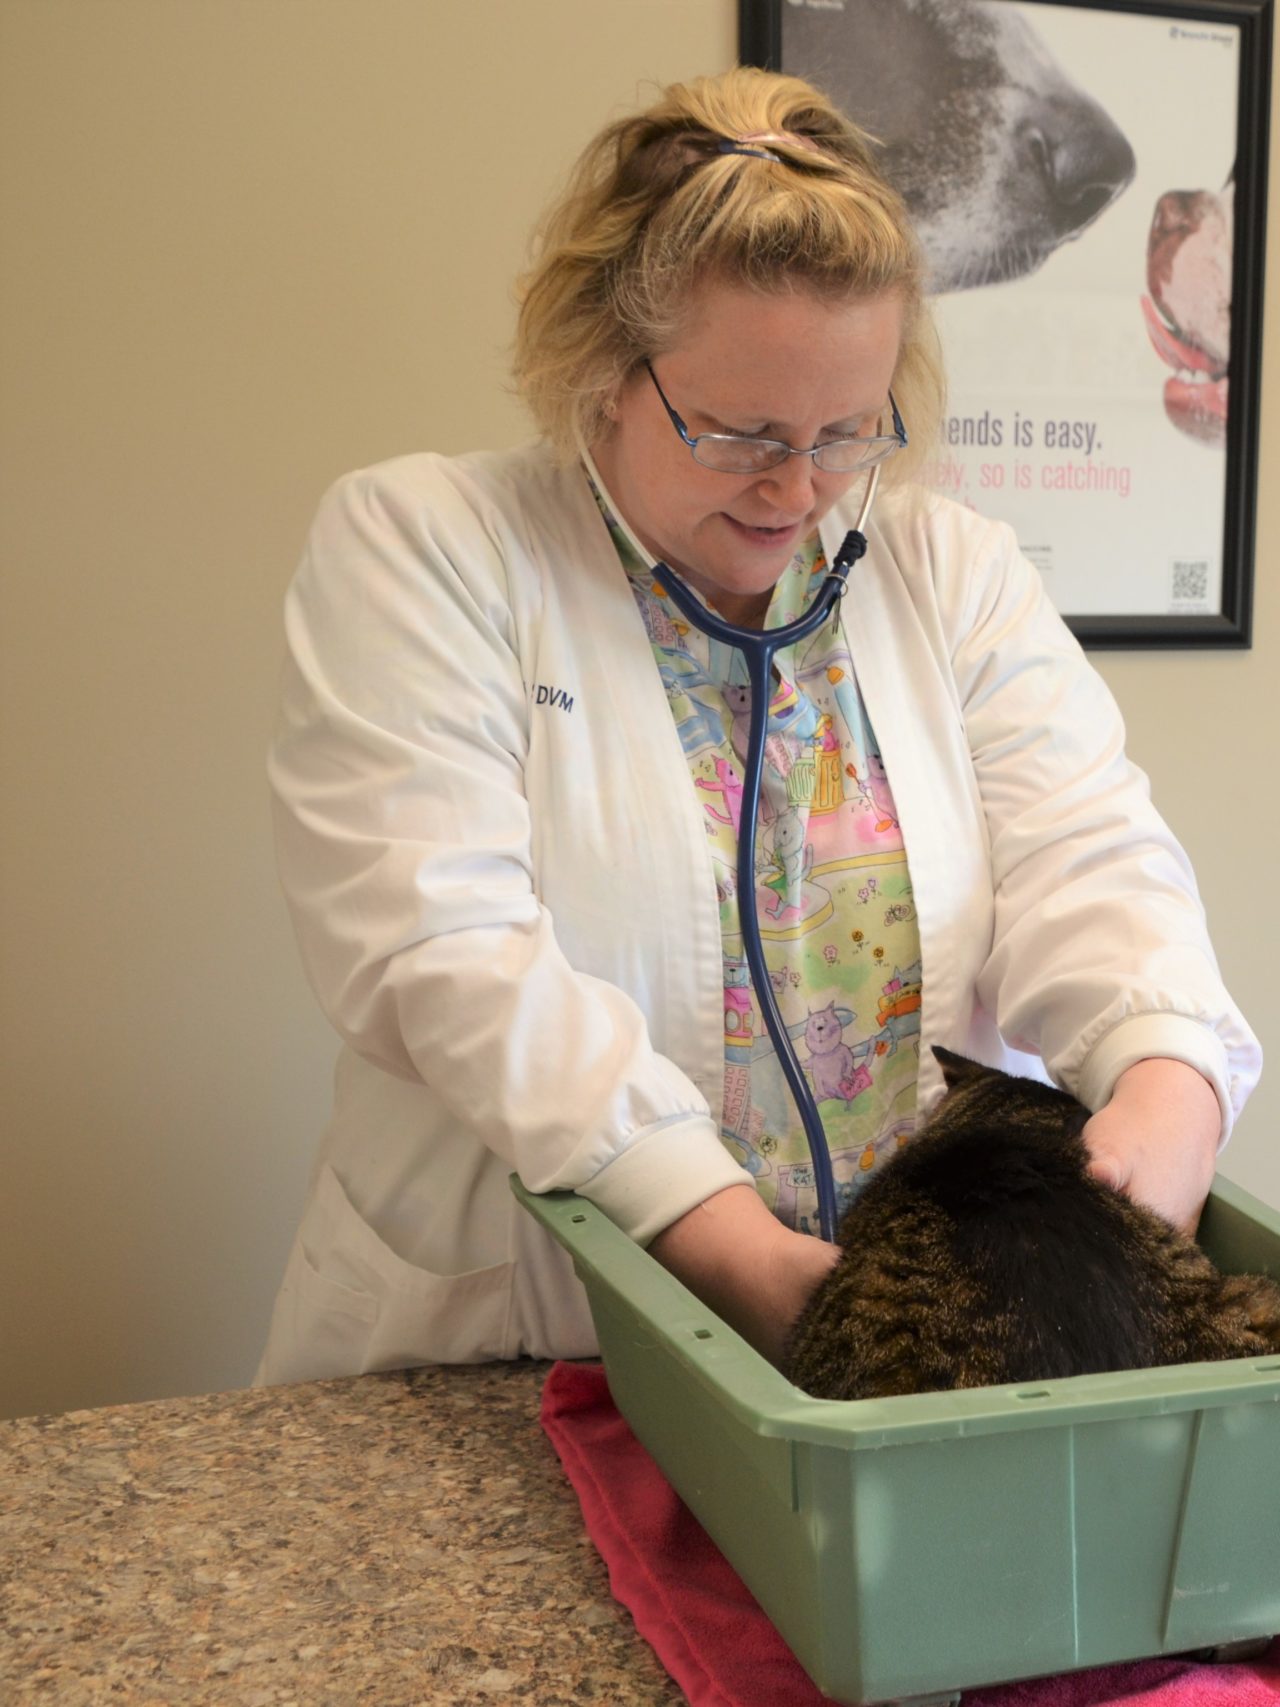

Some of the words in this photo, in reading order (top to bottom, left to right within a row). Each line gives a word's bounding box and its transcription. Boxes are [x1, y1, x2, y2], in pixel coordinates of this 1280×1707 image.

[1014, 411, 1033, 448] is
[1044, 420, 1102, 456] easy.
[979, 463, 1005, 490] so
[1014, 459, 1032, 490] is
[1041, 459, 1131, 498] catching
[536, 685, 574, 713] DVM
